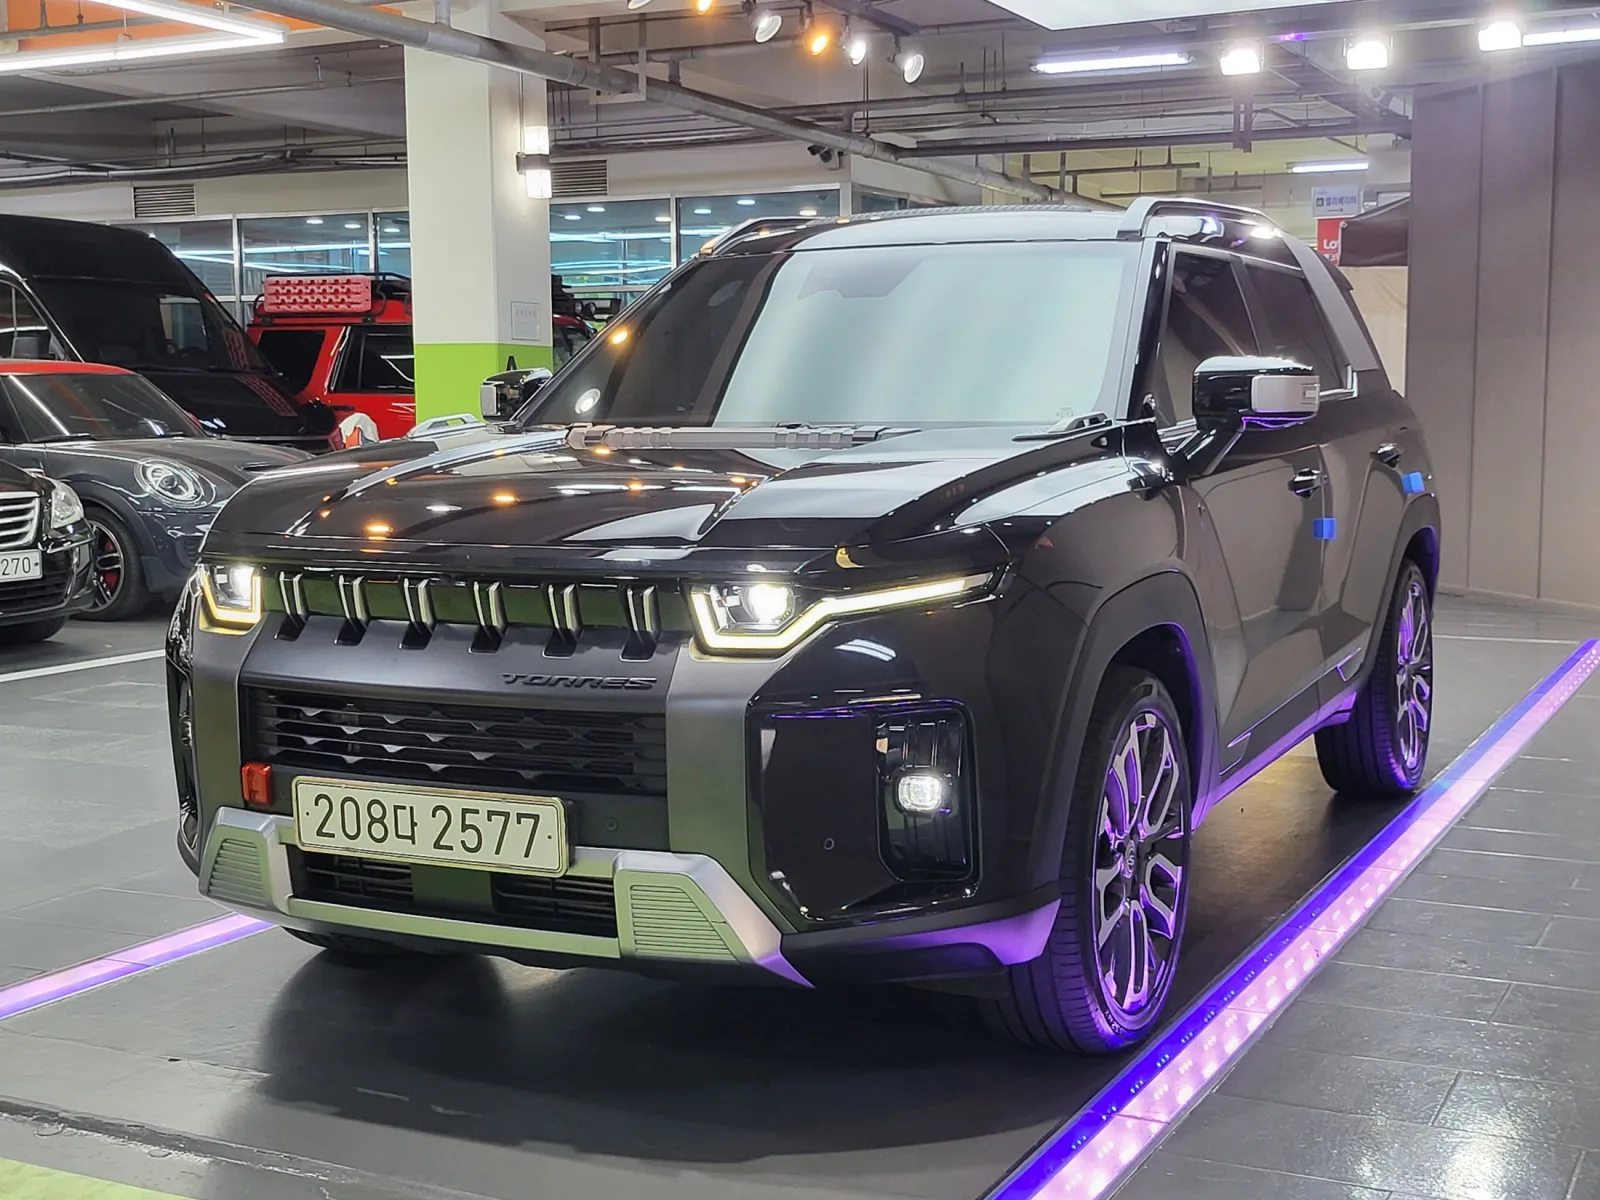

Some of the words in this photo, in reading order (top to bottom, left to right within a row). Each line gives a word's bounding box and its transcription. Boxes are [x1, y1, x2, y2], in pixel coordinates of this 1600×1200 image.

[0, 556, 31, 576] 270
[502, 673, 657, 690] TORRES
[314, 793, 418, 845] 208다
[431, 805, 540, 858] 2577
